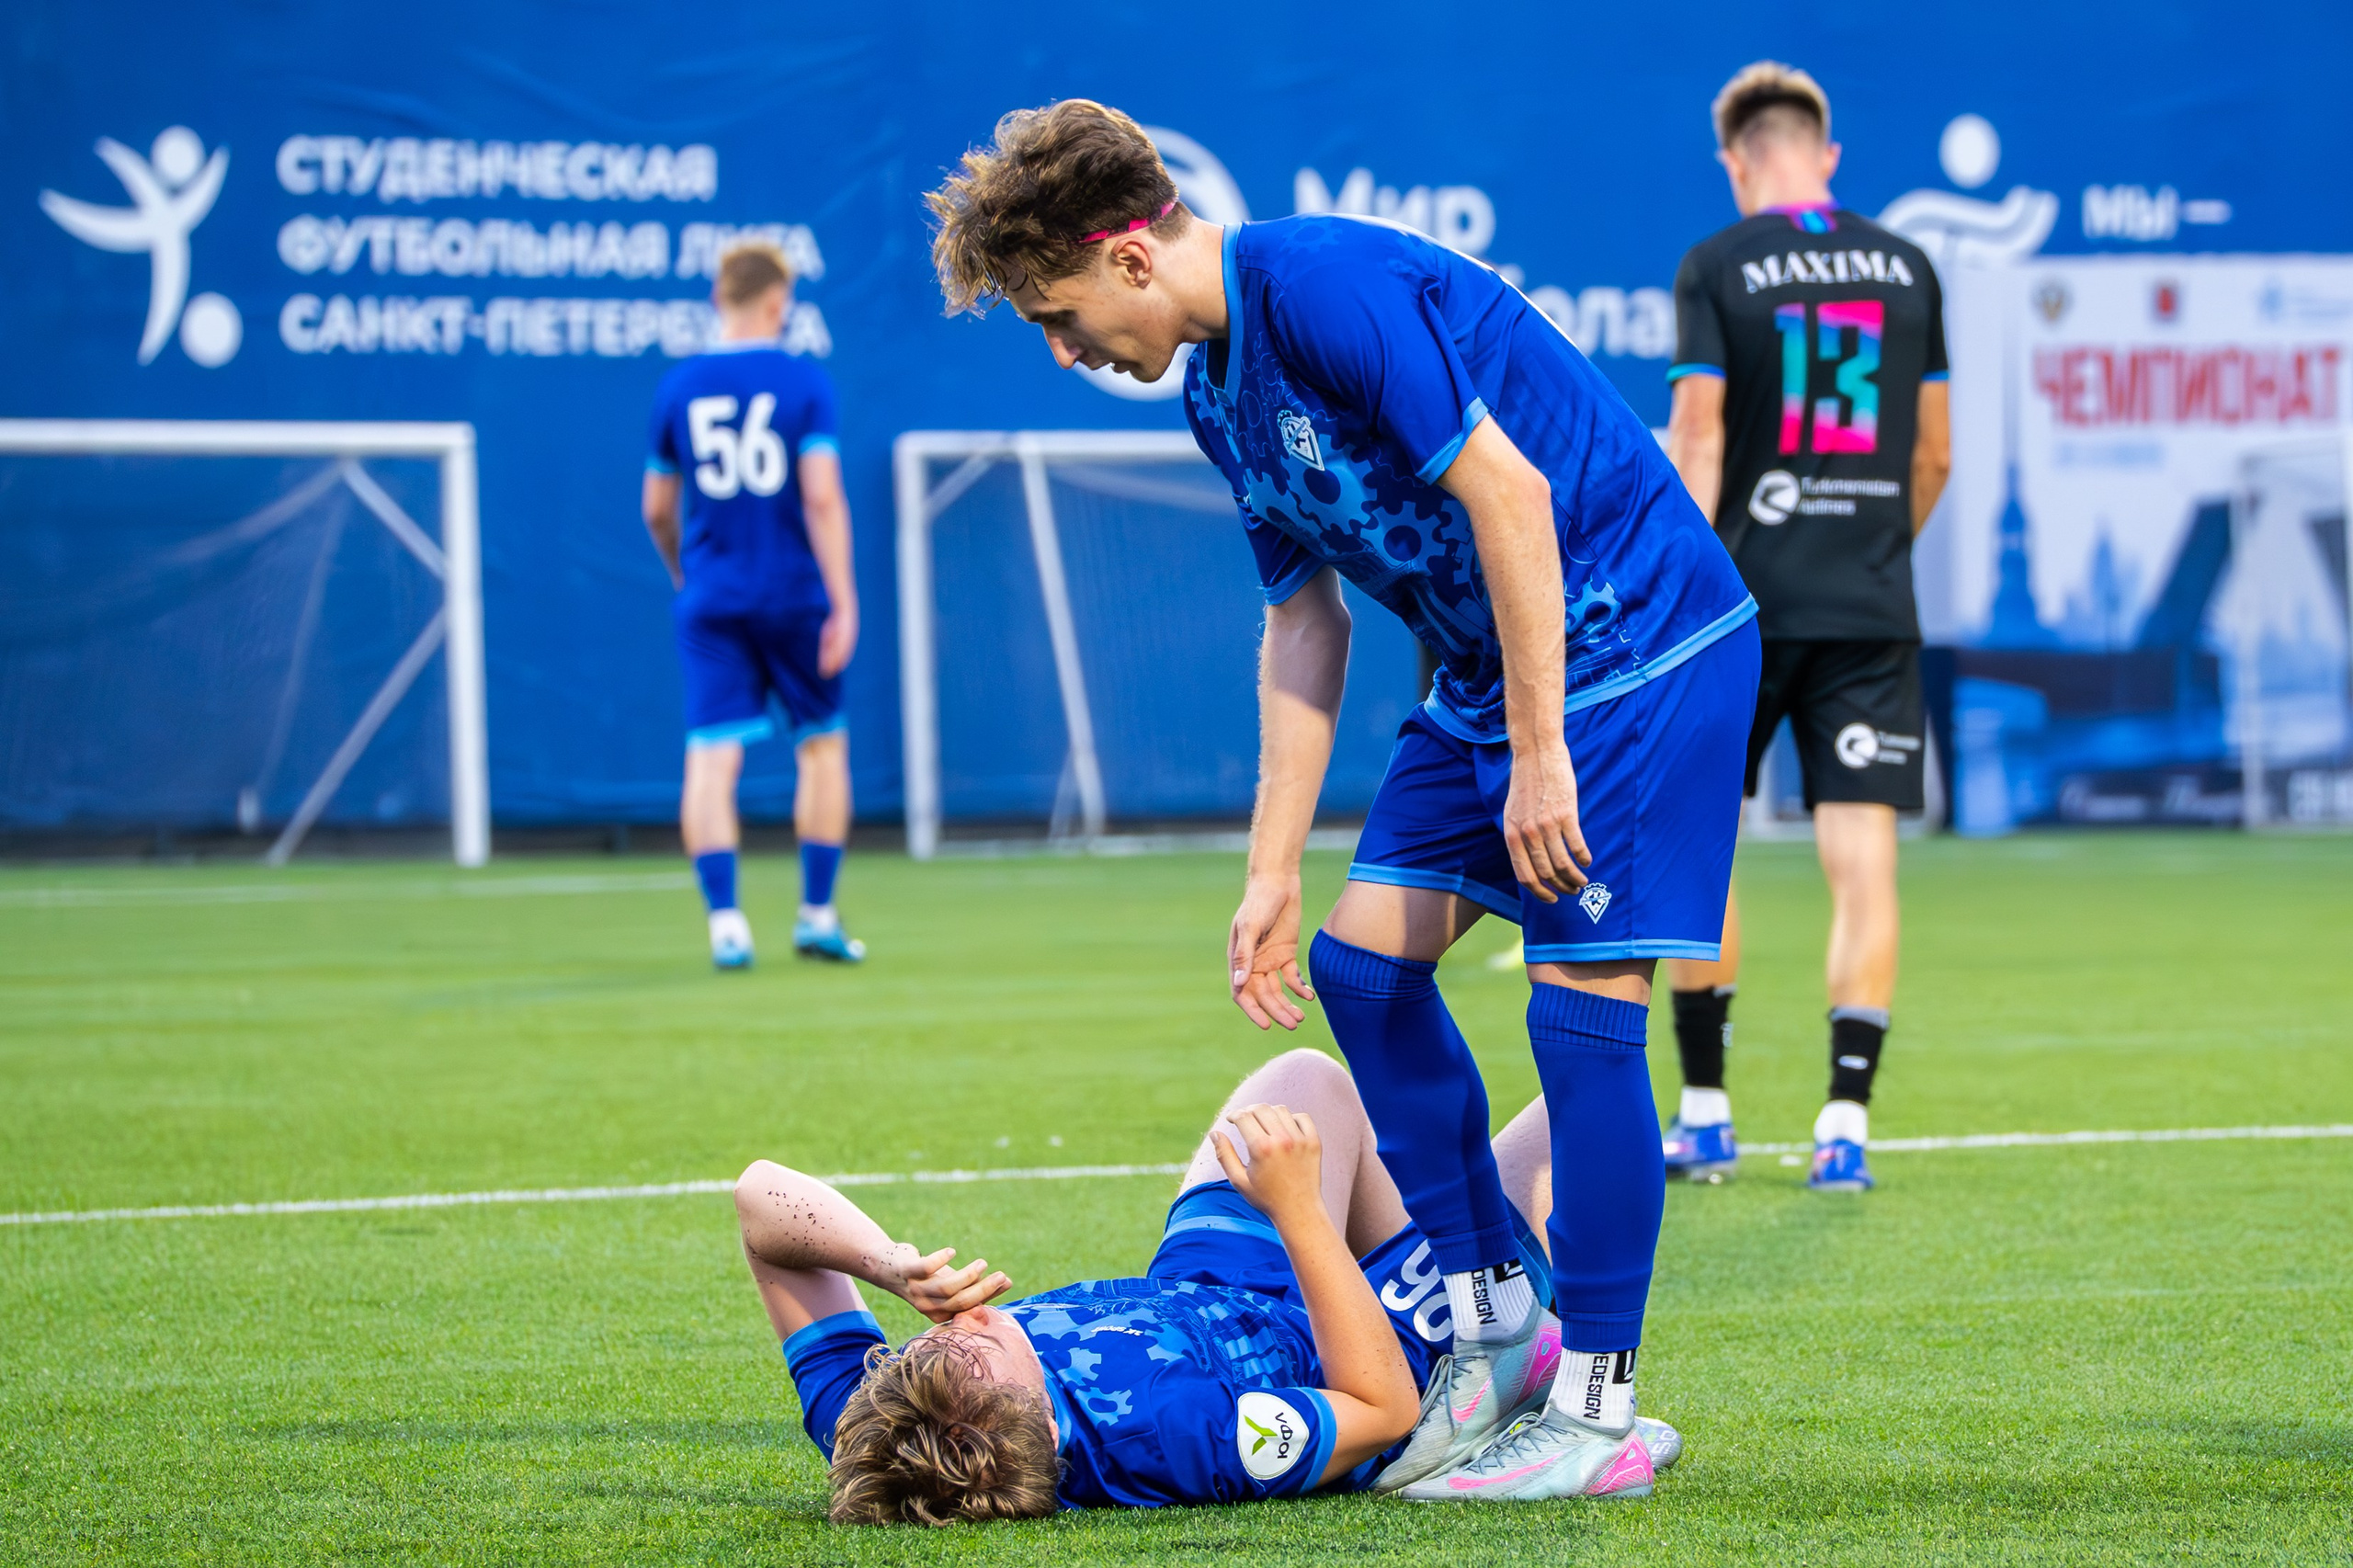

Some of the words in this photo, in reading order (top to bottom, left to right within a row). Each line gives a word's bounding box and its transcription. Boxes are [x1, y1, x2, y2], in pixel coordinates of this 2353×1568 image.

[277, 134, 718, 202] СТУДЕНЧЕСКАЯ
[278, 214, 669, 279] ФУТБОЛЬНАЯ
[1742, 249, 1914, 294] MAXIMA
[1774, 299, 1884, 456] 13
[2032, 344, 2340, 426] ЧЕМПИОНАТ
[688, 392, 788, 500] 56
[1583, 1352, 1609, 1420] EDESIGN
